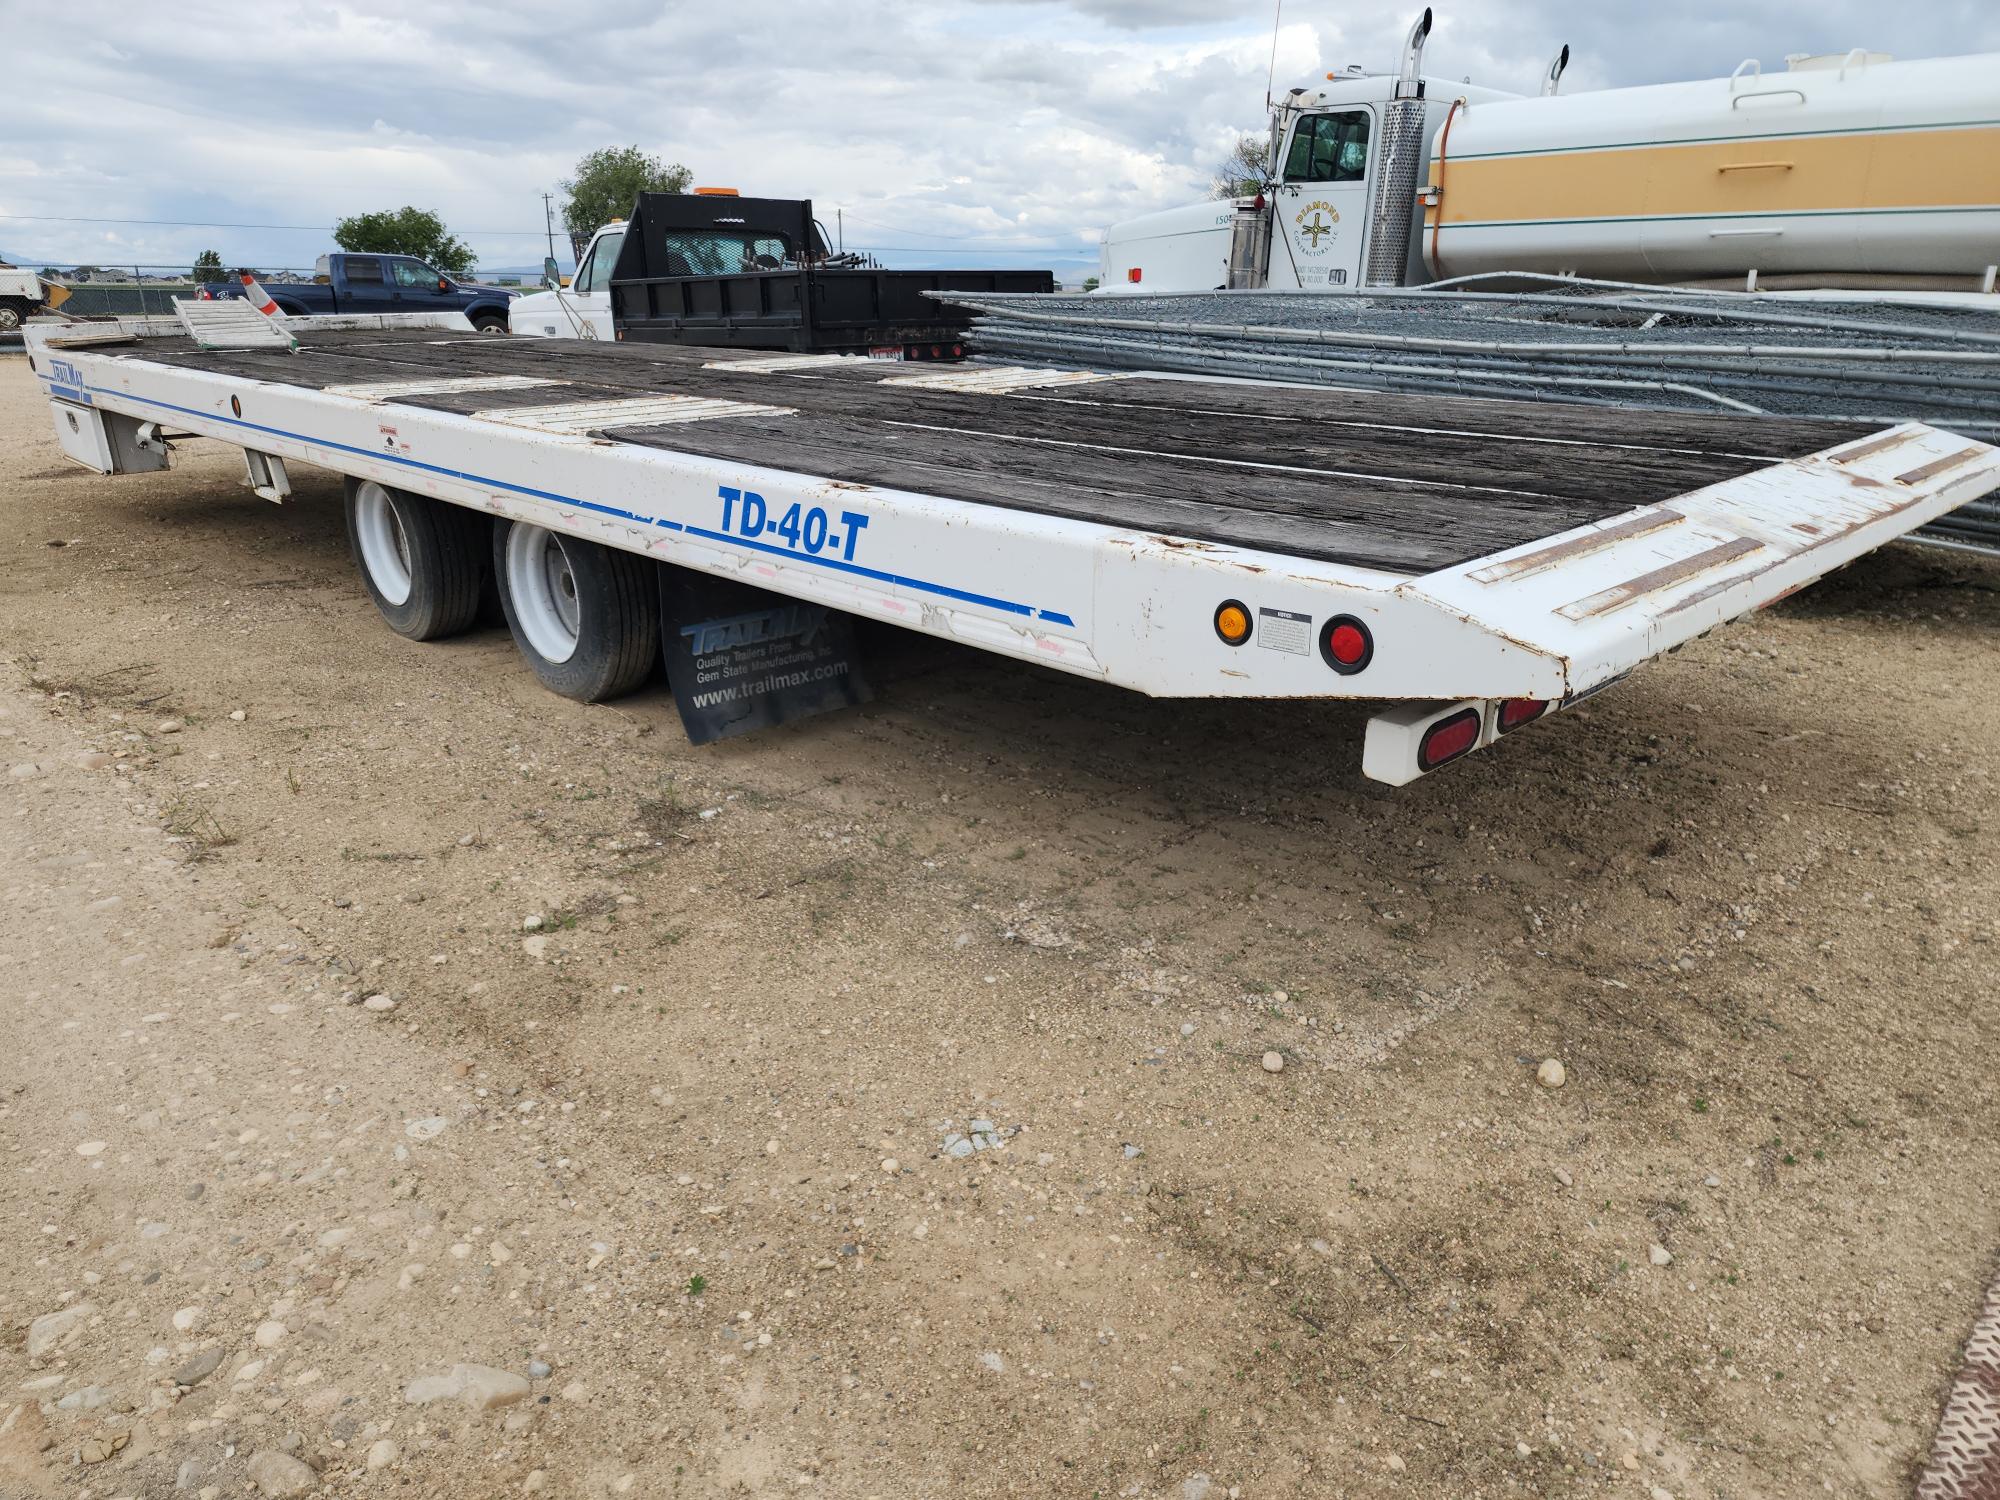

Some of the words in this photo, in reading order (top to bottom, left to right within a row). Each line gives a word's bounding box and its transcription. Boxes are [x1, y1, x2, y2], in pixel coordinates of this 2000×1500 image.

[1296, 201, 1340, 224] DIAMOND
[718, 485, 869, 561] TD-40-T
[697, 655, 730, 670] Quality
[735, 647, 767, 661] Trailers
[769, 642, 792, 655] From
[692, 661, 849, 709] www.trailmax.com
[697, 672, 720, 684] Gem
[723, 665, 748, 678] State
